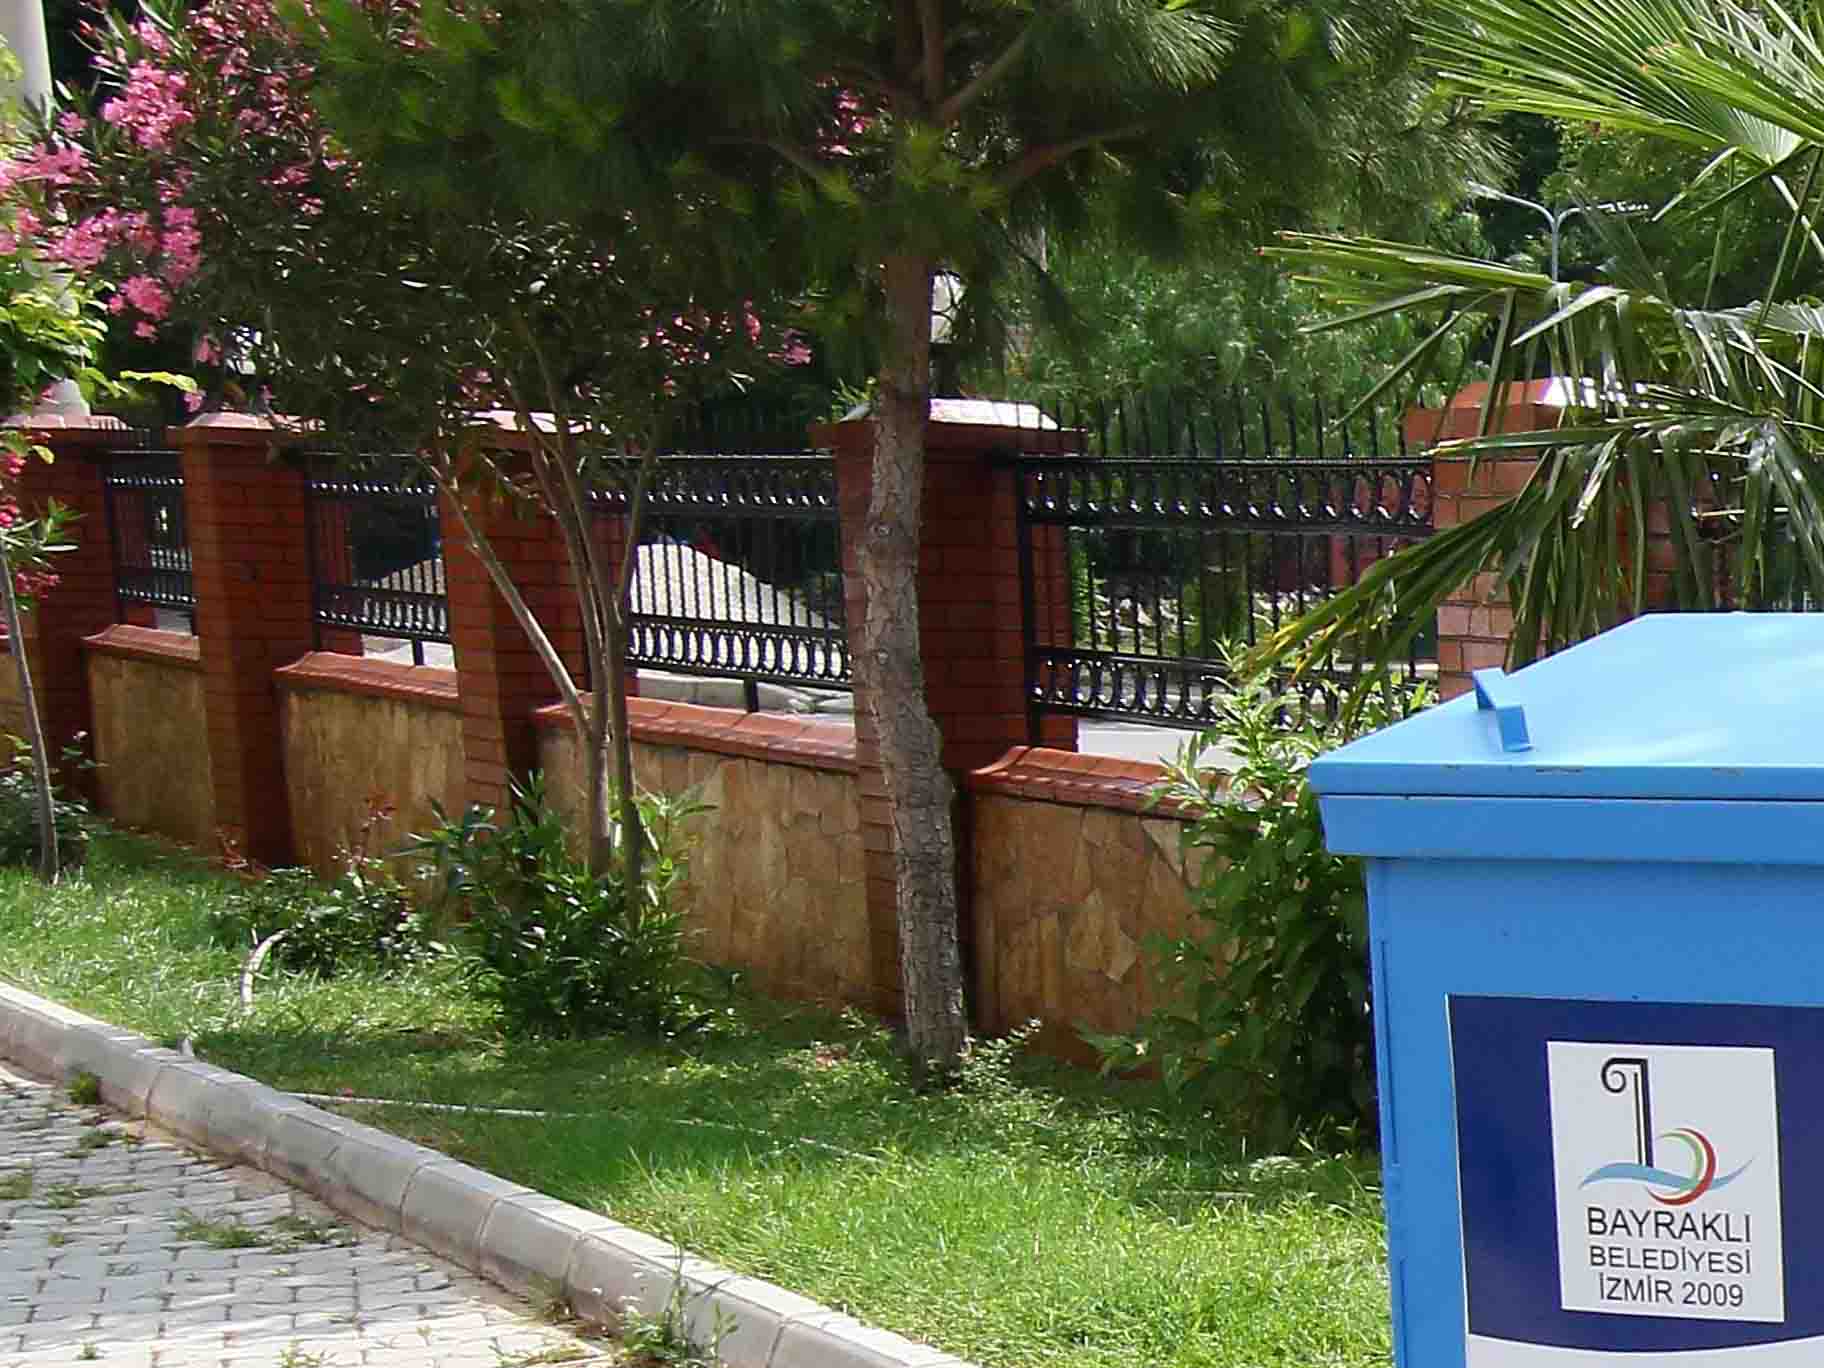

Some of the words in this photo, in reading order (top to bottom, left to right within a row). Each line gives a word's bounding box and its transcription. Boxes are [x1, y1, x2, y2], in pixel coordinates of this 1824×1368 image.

[1587, 1206, 1751, 1243] BAYRAKLI
[1589, 1245, 1751, 1275] BELEDİYESİ
[1599, 1272, 1674, 1304] İZMİR
[1681, 1281, 1744, 1307] 2009
